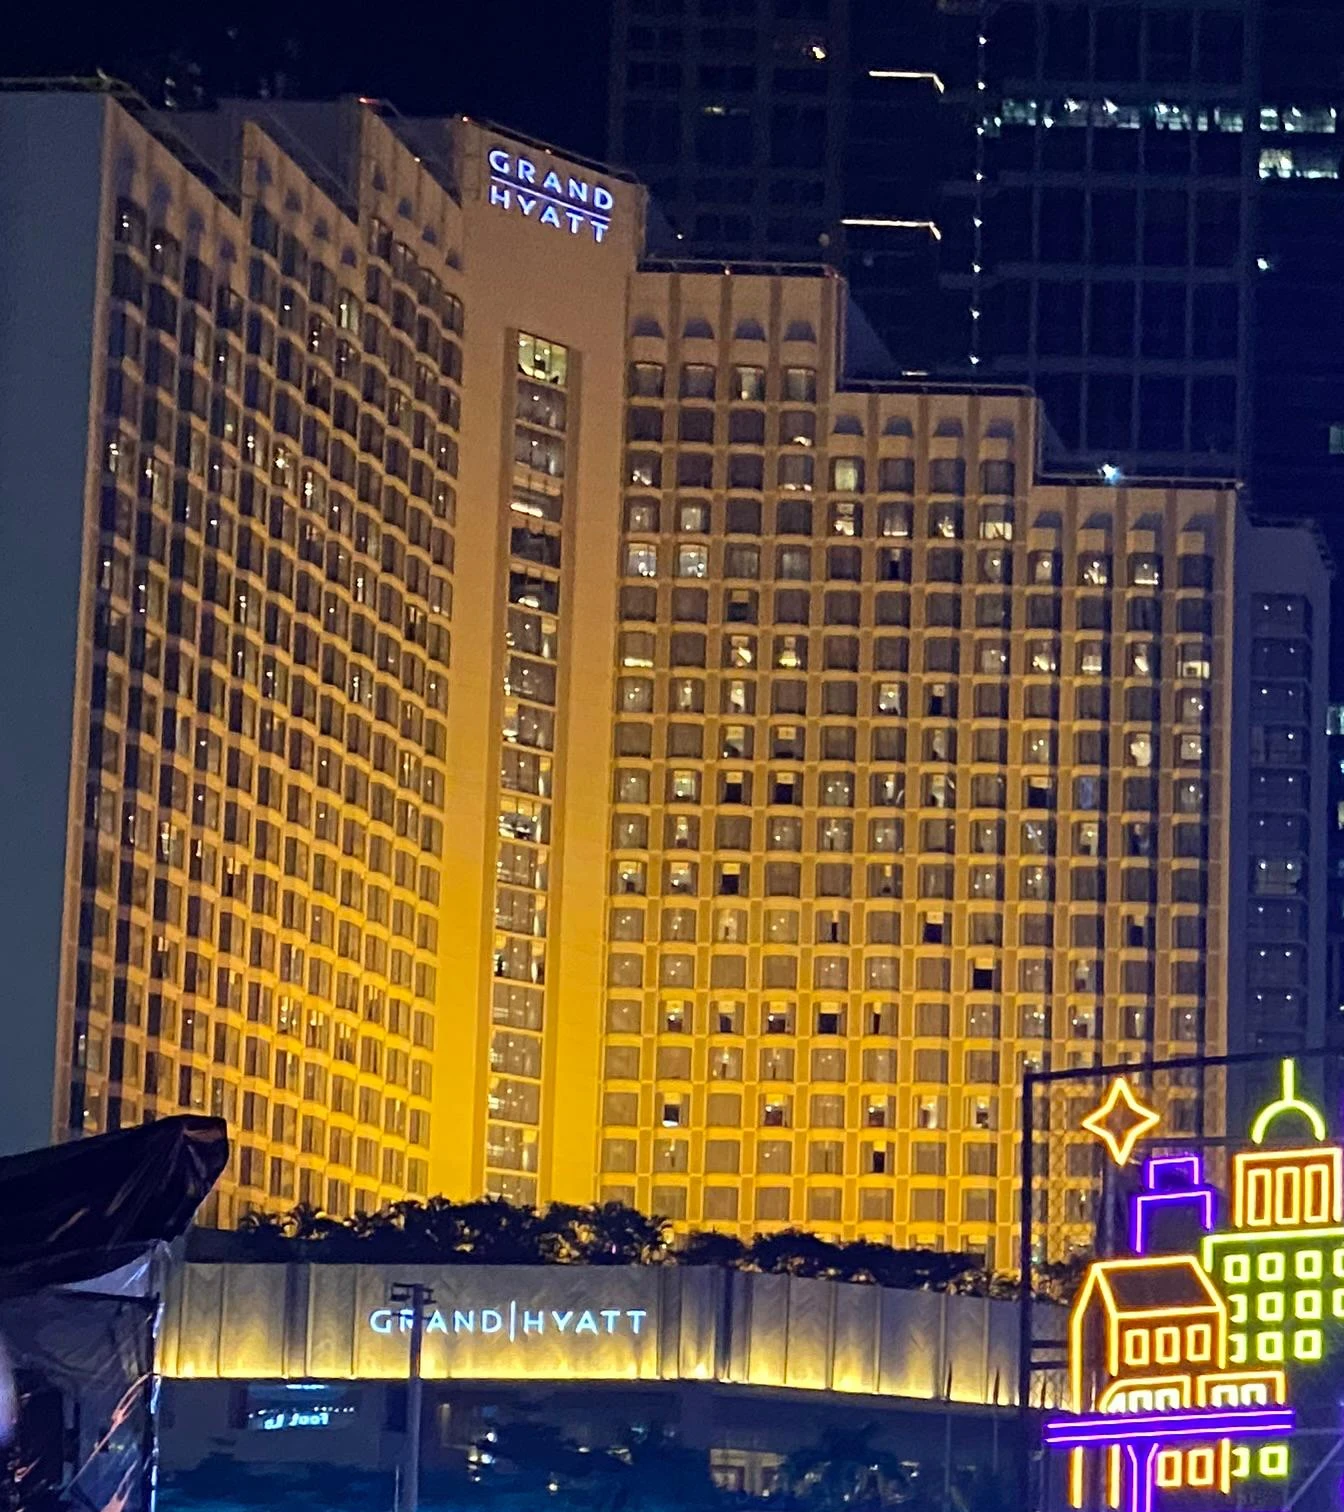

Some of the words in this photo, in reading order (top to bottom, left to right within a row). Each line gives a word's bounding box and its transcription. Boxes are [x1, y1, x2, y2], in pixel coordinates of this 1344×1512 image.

[488, 149, 614, 211] GRAND
[489, 184, 610, 243] HYATT
[523, 1310, 648, 1335] HYATT
